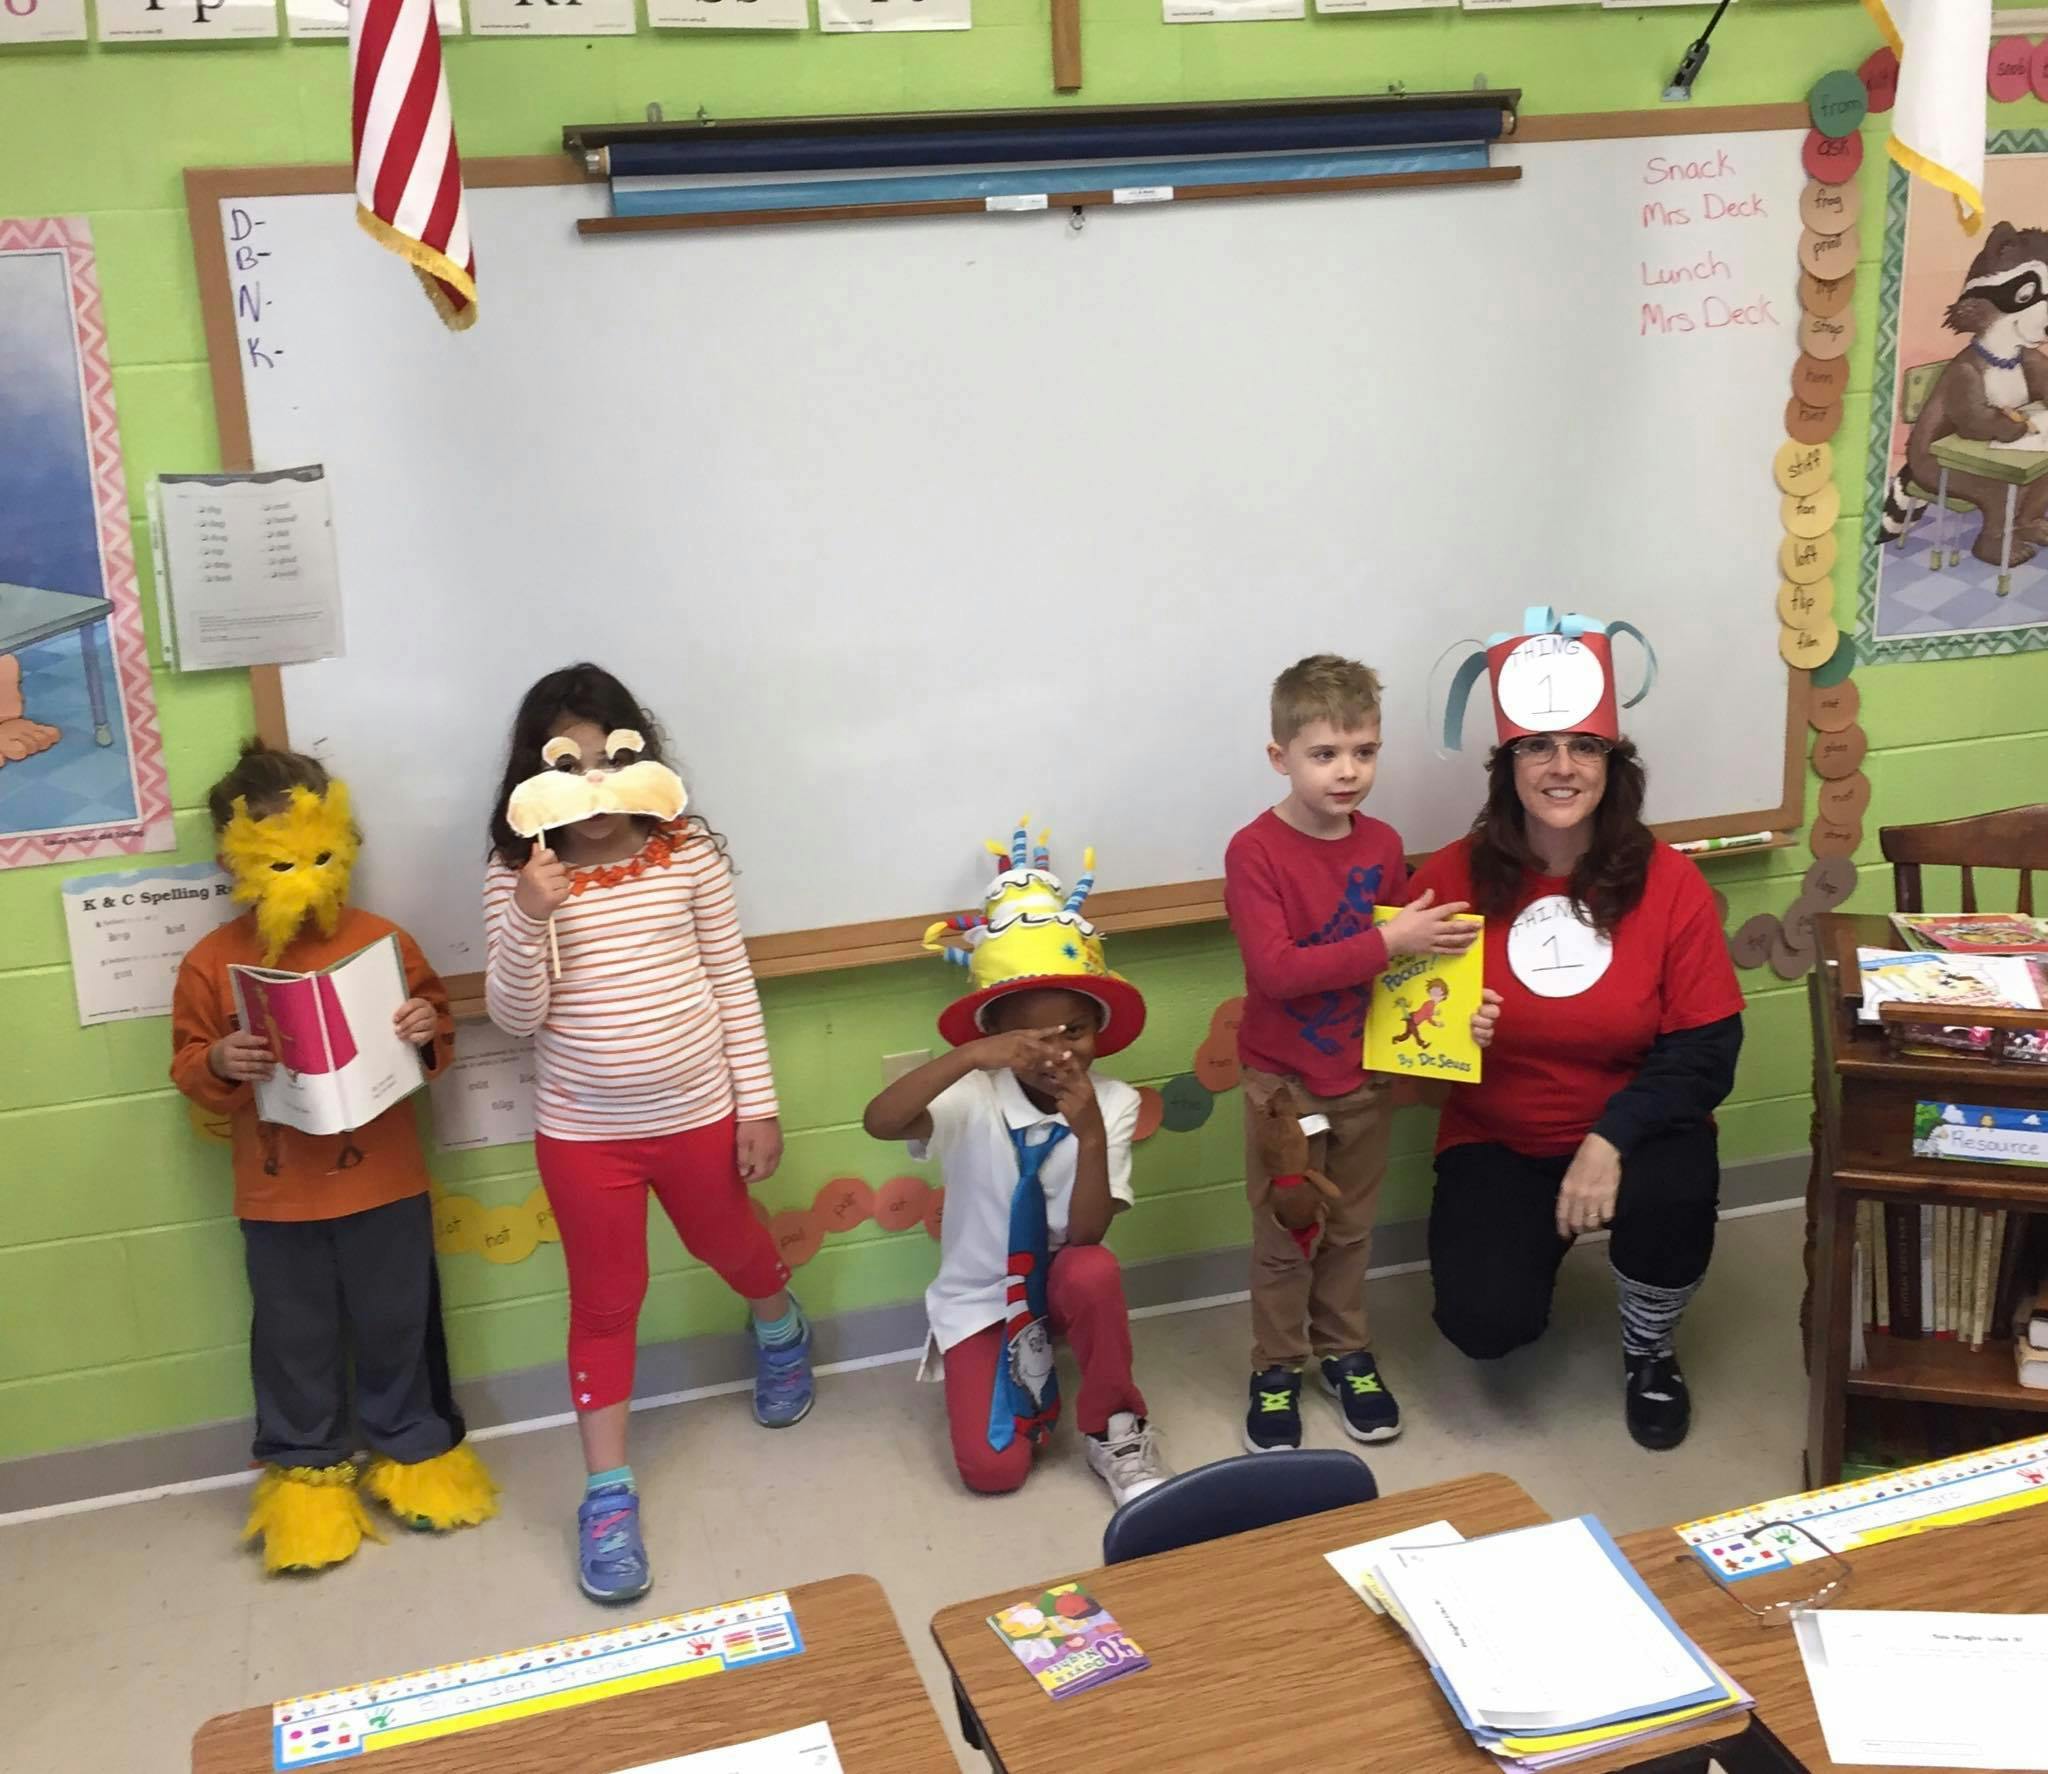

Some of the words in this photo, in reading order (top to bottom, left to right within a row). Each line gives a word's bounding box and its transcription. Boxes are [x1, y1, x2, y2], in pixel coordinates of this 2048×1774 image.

[1820, 91, 1863, 118] from
[1642, 149, 1736, 185] Snack
[1641, 203, 1692, 228] Mrs
[1703, 193, 1769, 221] Deck
[1641, 250, 1733, 287] Lunch
[1640, 303, 1696, 336] Mrs
[1702, 296, 1781, 330] Deck
[1509, 638, 1580, 667] THING
[1531, 674, 1571, 715] 1
[83, 898, 97, 912] K
[102, 896, 117, 909] &
[122, 894, 136, 906] C
[140, 887, 210, 906] Spelling
[1531, 934, 1585, 973] 1
[1438, 1053, 1472, 1073] Seuss
[1950, 1130, 2041, 1156] Resource
